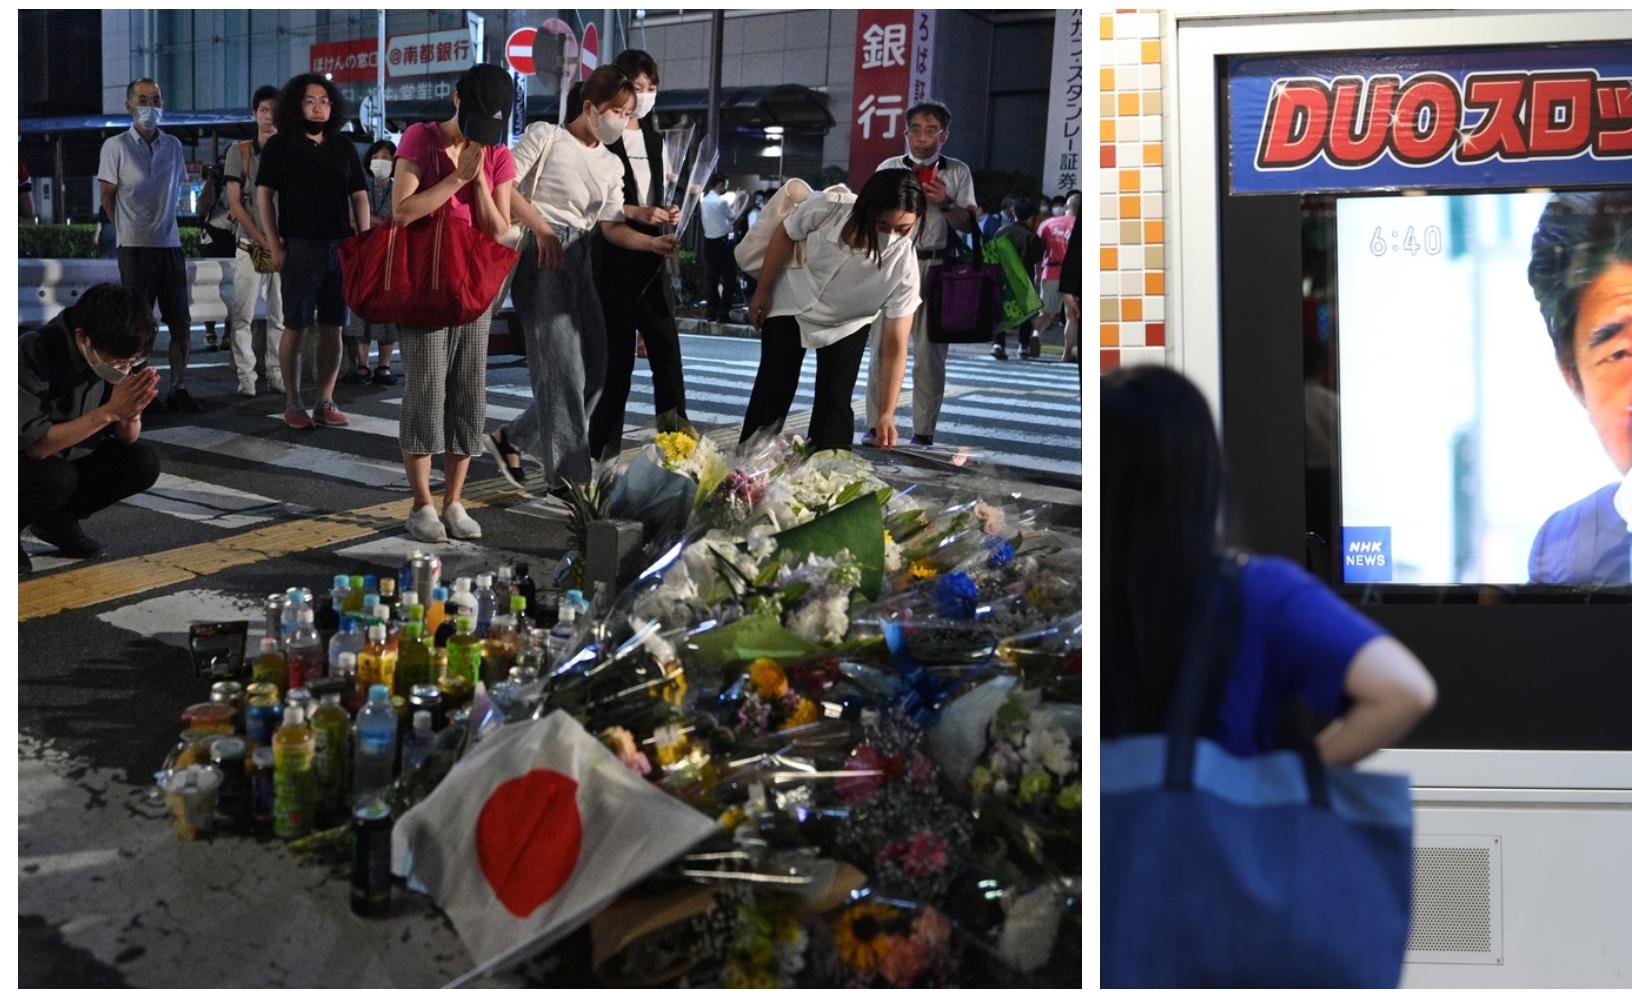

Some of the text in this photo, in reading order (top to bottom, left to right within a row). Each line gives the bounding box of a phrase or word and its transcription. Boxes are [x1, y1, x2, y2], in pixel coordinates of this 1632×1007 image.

[858, 23, 906, 139] 銀行
[1370, 225, 1442, 257] 6:40
[1349, 541, 1382, 553] NHK
[1346, 554, 1386, 566] NEWS
